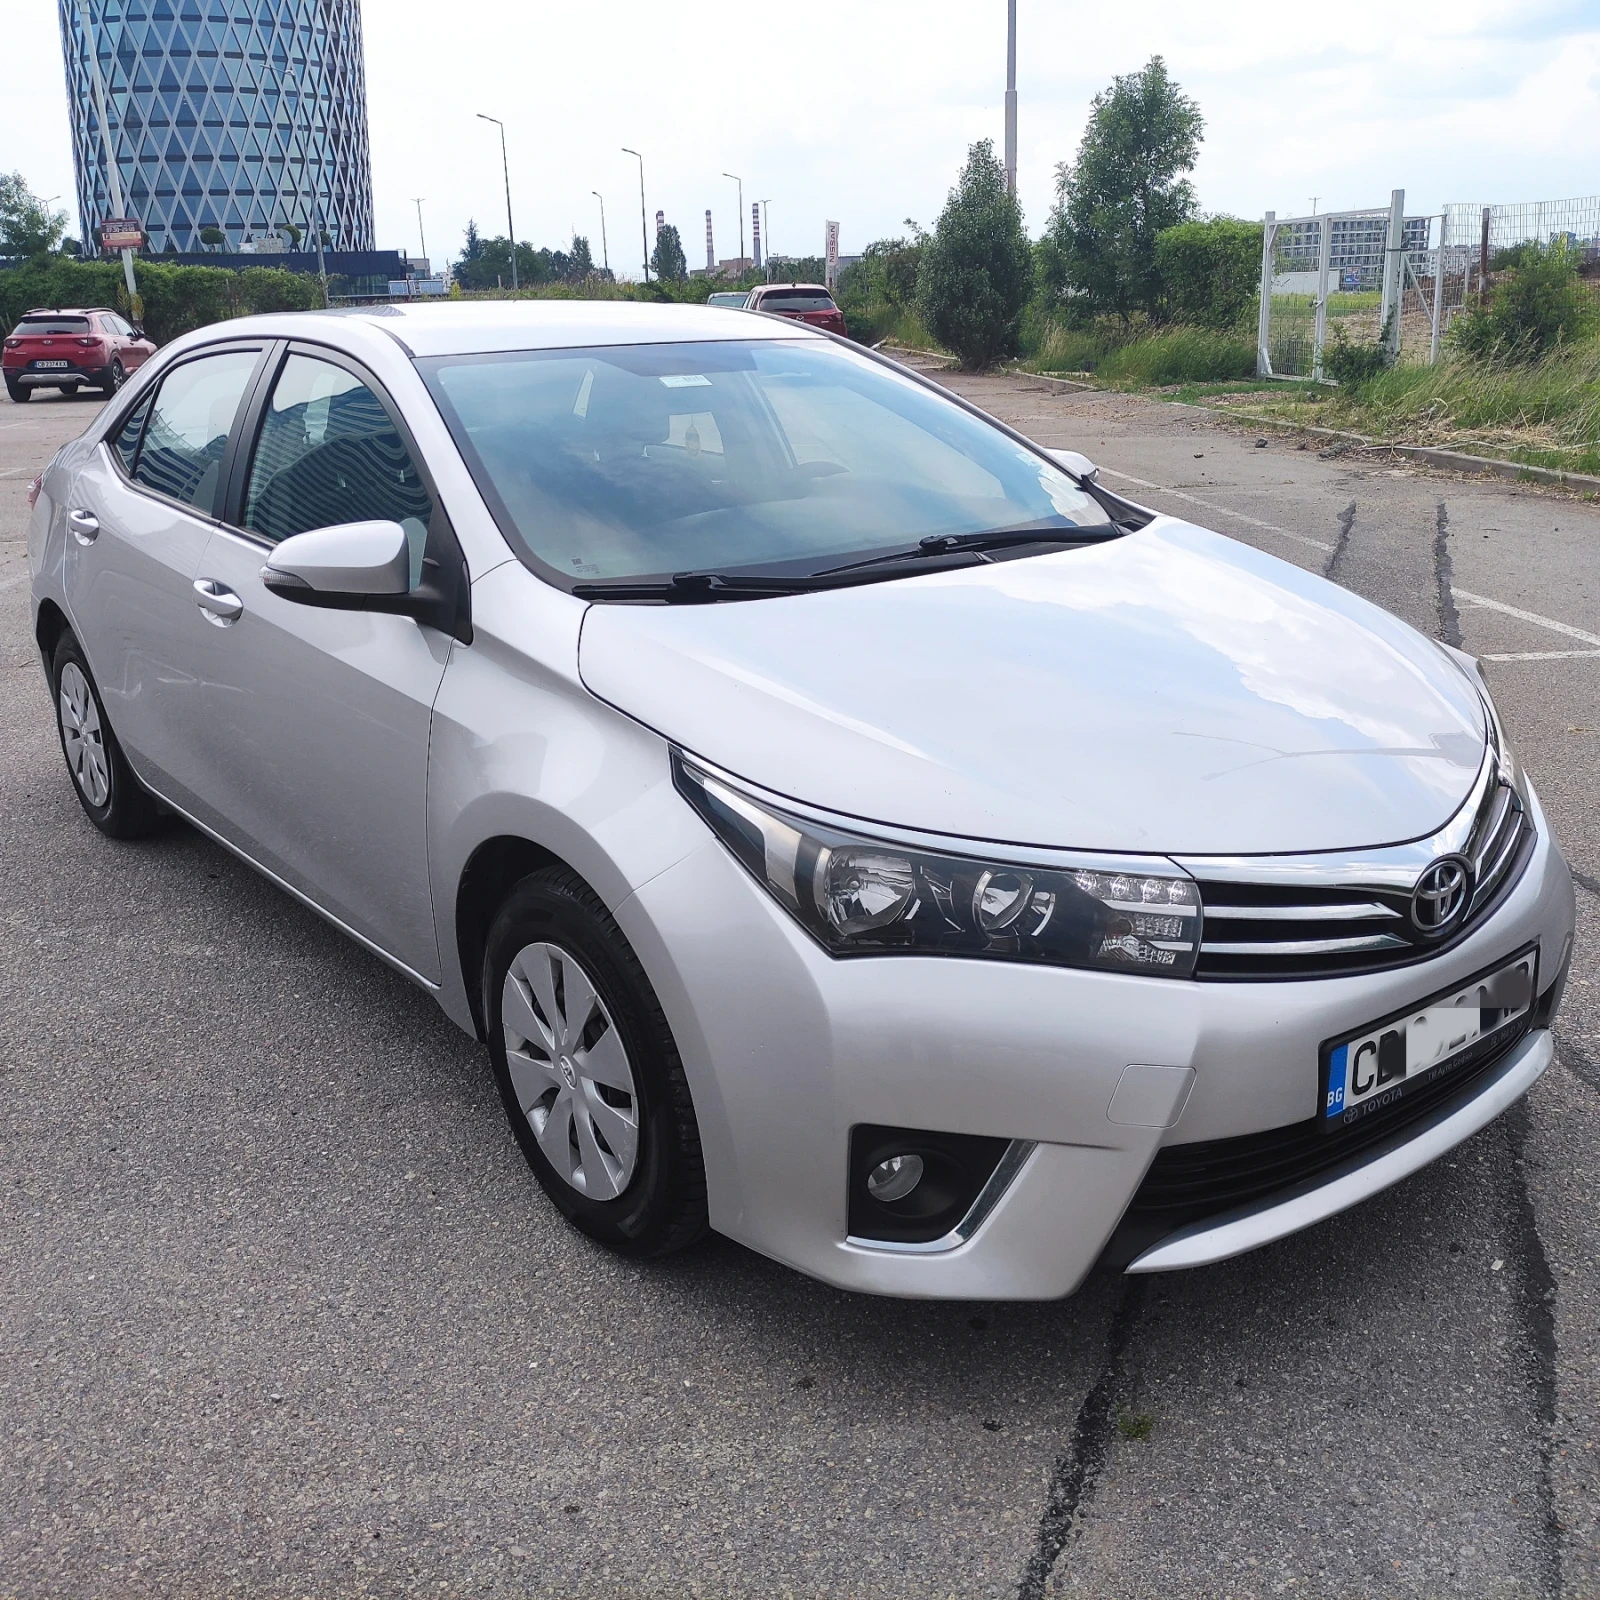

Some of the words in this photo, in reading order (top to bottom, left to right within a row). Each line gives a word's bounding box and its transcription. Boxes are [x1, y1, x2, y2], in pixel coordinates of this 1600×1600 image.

[824, 225, 836, 263] NISSAN
[1326, 1086, 1343, 1107] BG
[1362, 1087, 1403, 1114] TOYOTA
